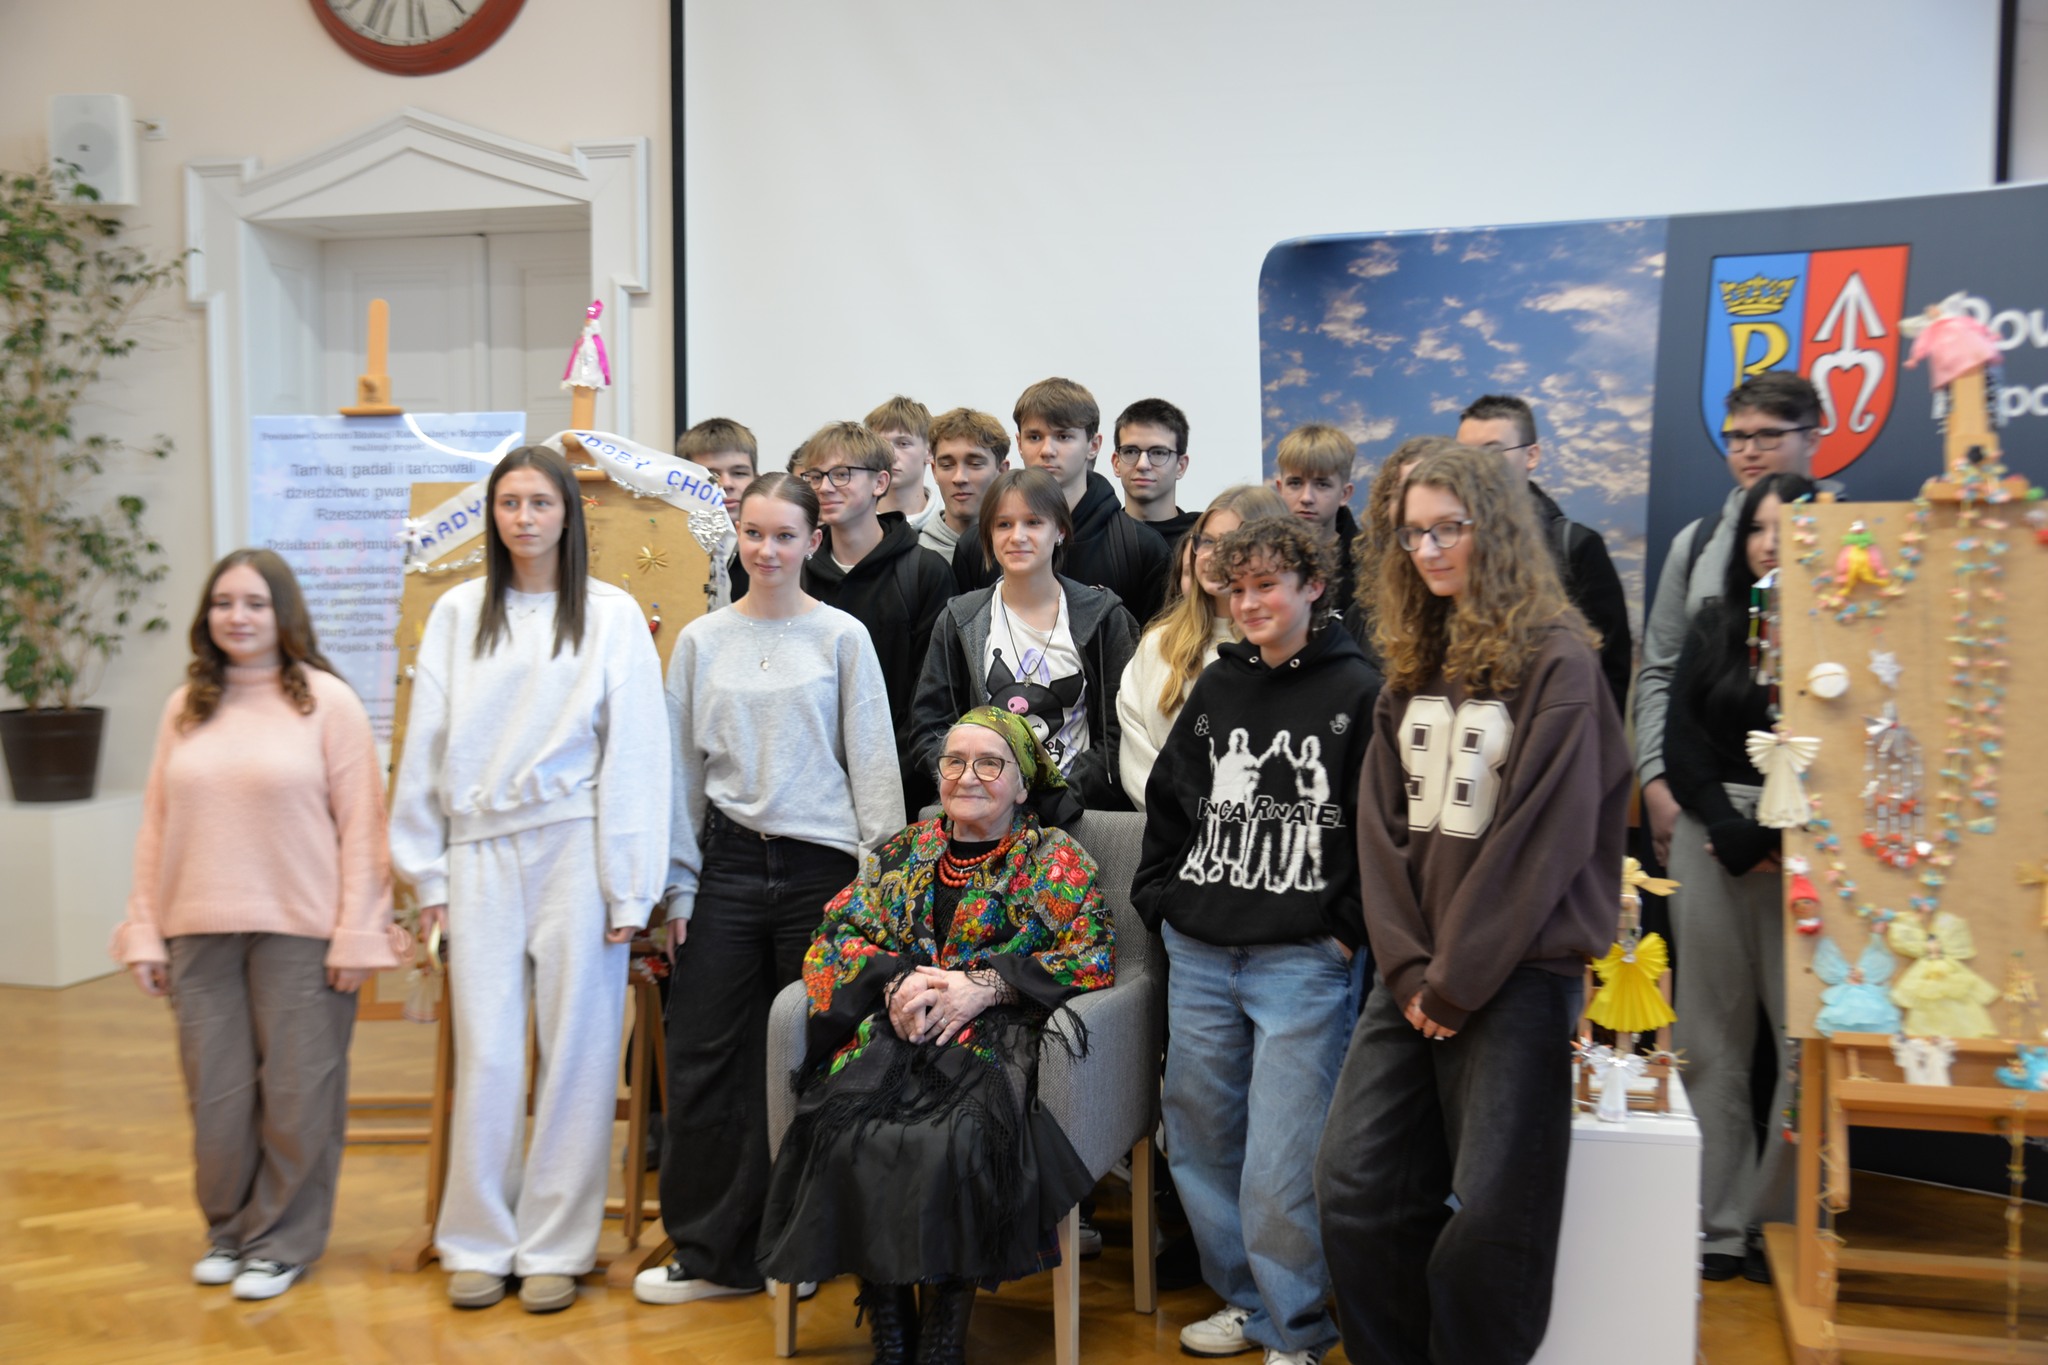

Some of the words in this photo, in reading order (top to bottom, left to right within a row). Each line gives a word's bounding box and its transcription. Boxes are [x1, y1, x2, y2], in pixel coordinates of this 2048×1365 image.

[290, 463, 322, 476] Tam
[352, 462, 395, 479] gadali
[285, 486, 370, 499] dziedzictwo
[375, 487, 412, 501] gwar
[316, 508, 411, 521] Rzeszowszc
[1397, 695, 1515, 839] 98
[1197, 794, 1343, 829] INCARNATE
